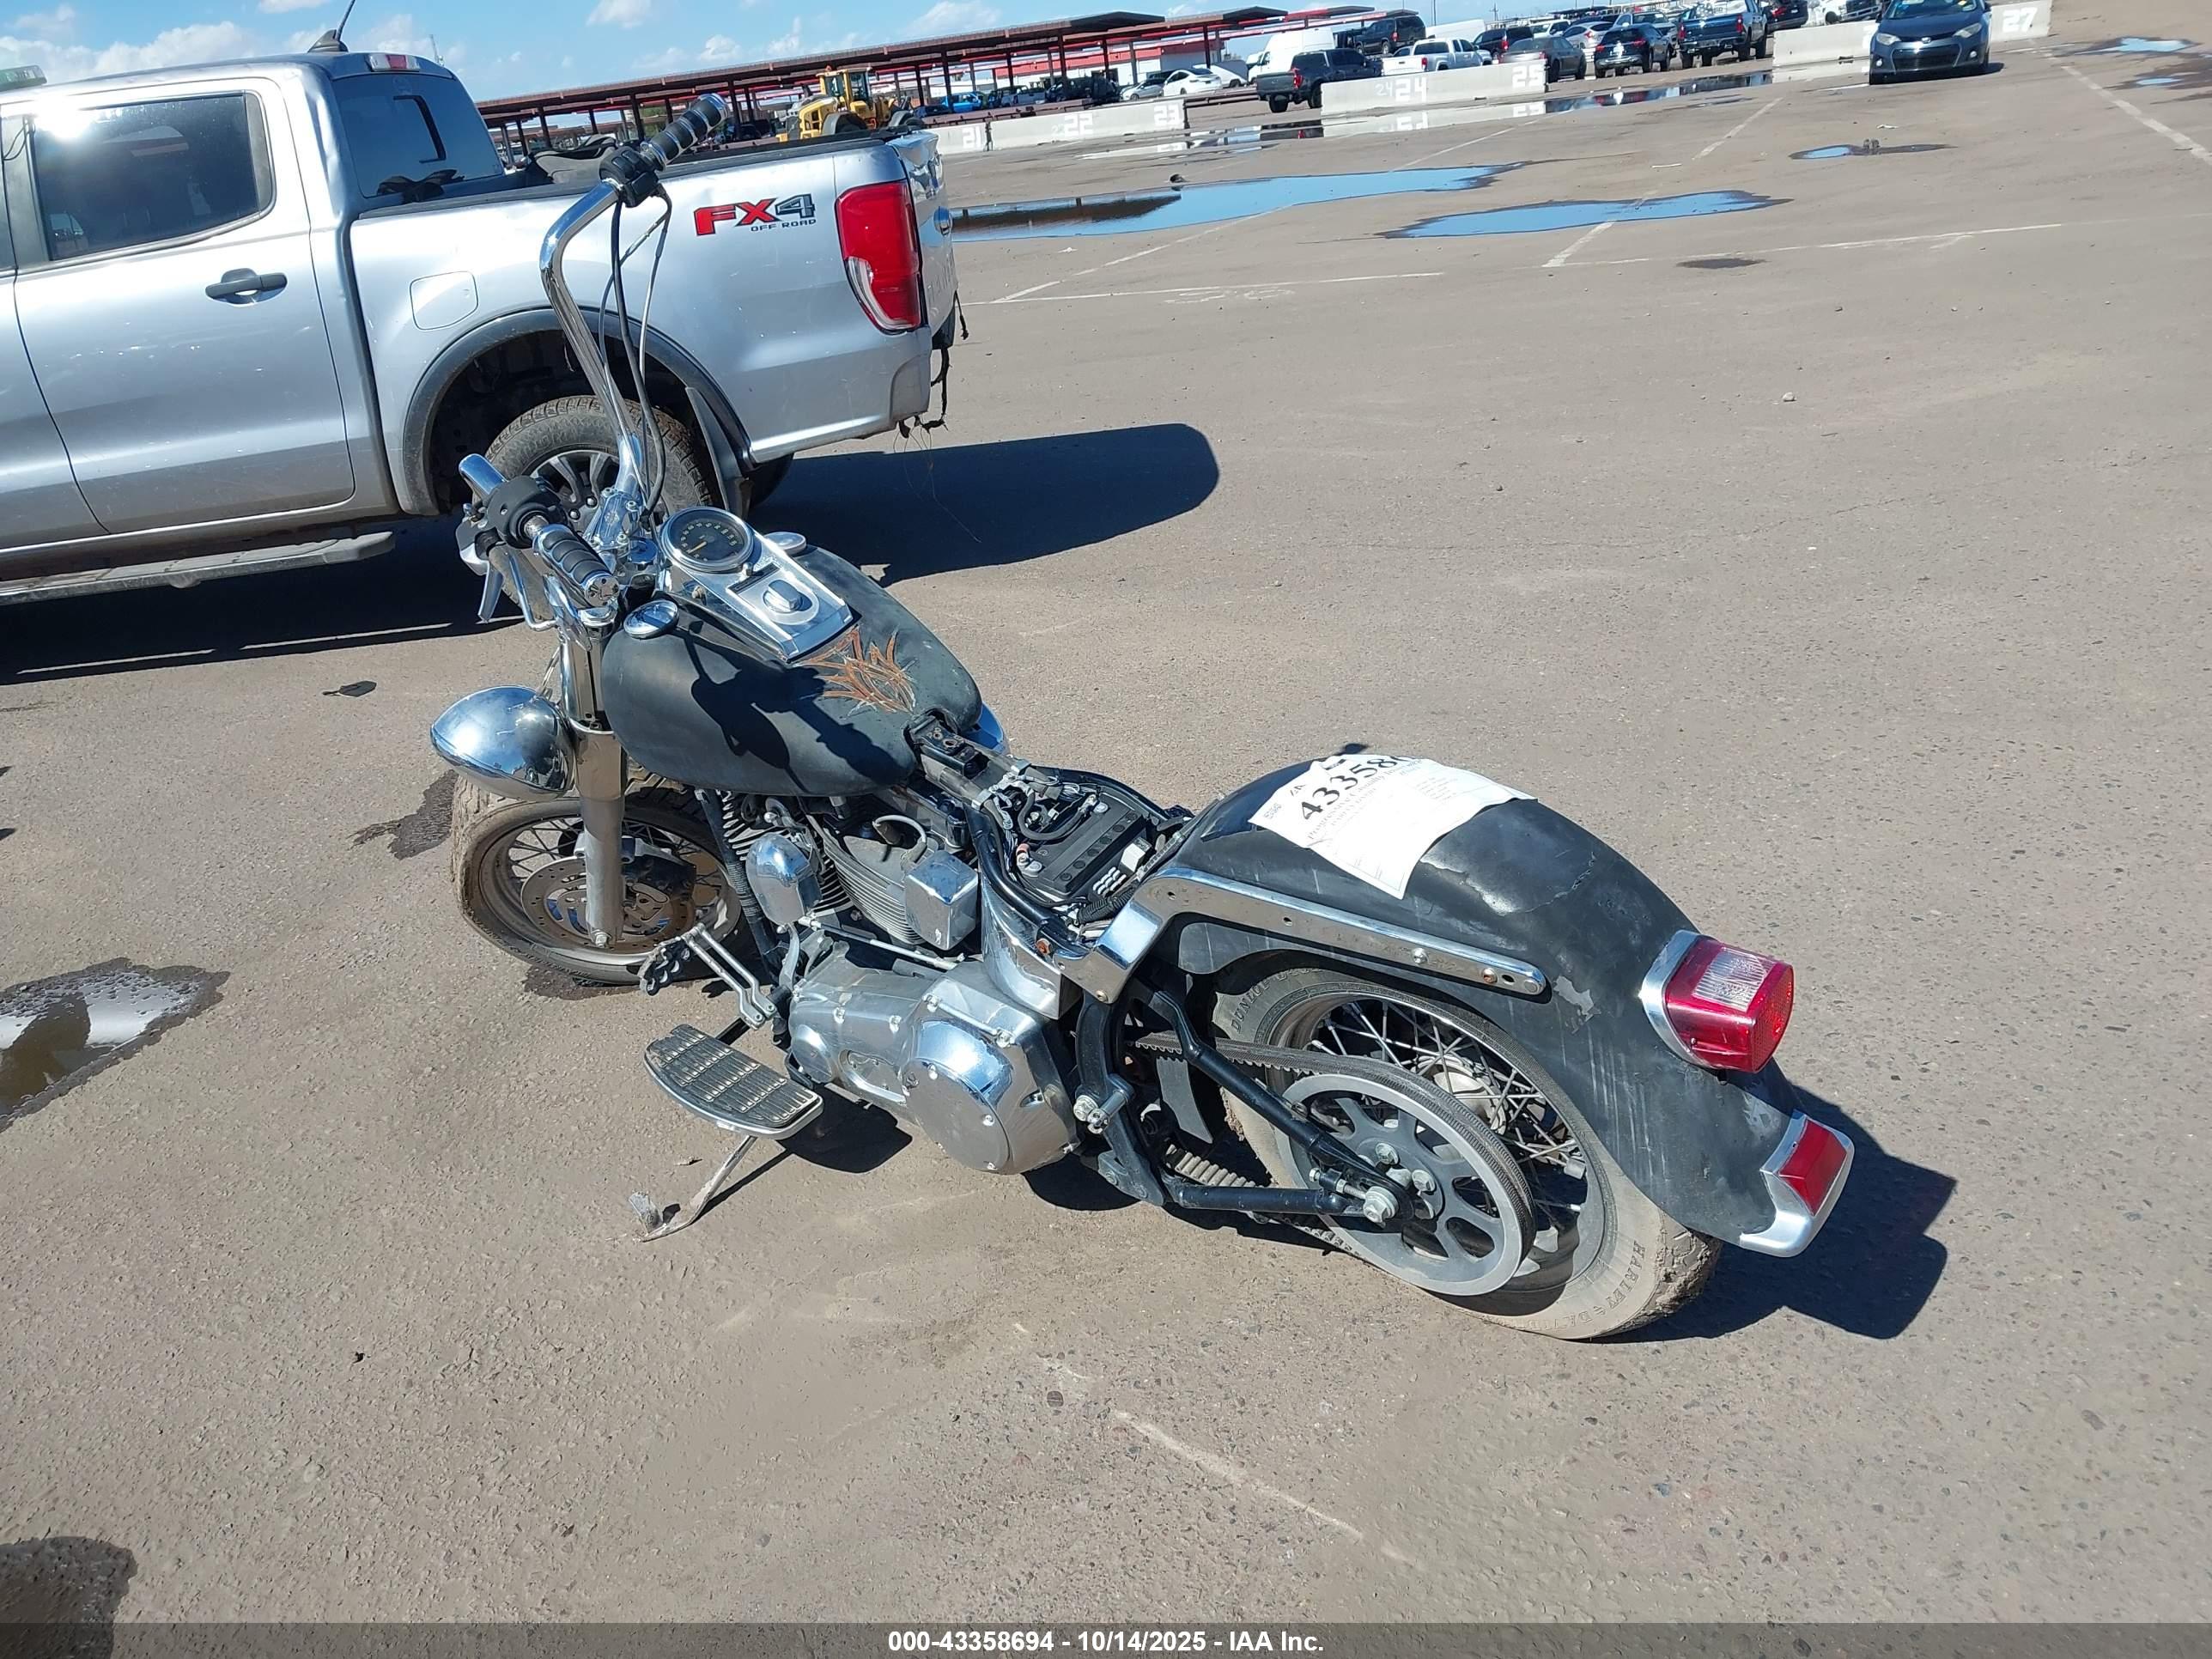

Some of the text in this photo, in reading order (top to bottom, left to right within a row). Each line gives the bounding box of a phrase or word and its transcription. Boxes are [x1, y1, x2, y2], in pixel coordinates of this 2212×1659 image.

[2002, 7, 2038, 33] 27
[1512, 64, 1544, 88] 25
[1375, 81, 1393, 97] 24
[1395, 76, 1427, 103] 24
[1064, 112, 1093, 137] 22
[1154, 104, 1179, 126] 23
[962, 126, 981, 149] 21
[693, 193, 816, 236] FX4
[781, 218, 817, 229] ROAD
[1301, 756, 1413, 820] 43358
[1606, 1240, 1646, 1310] HARLEY
